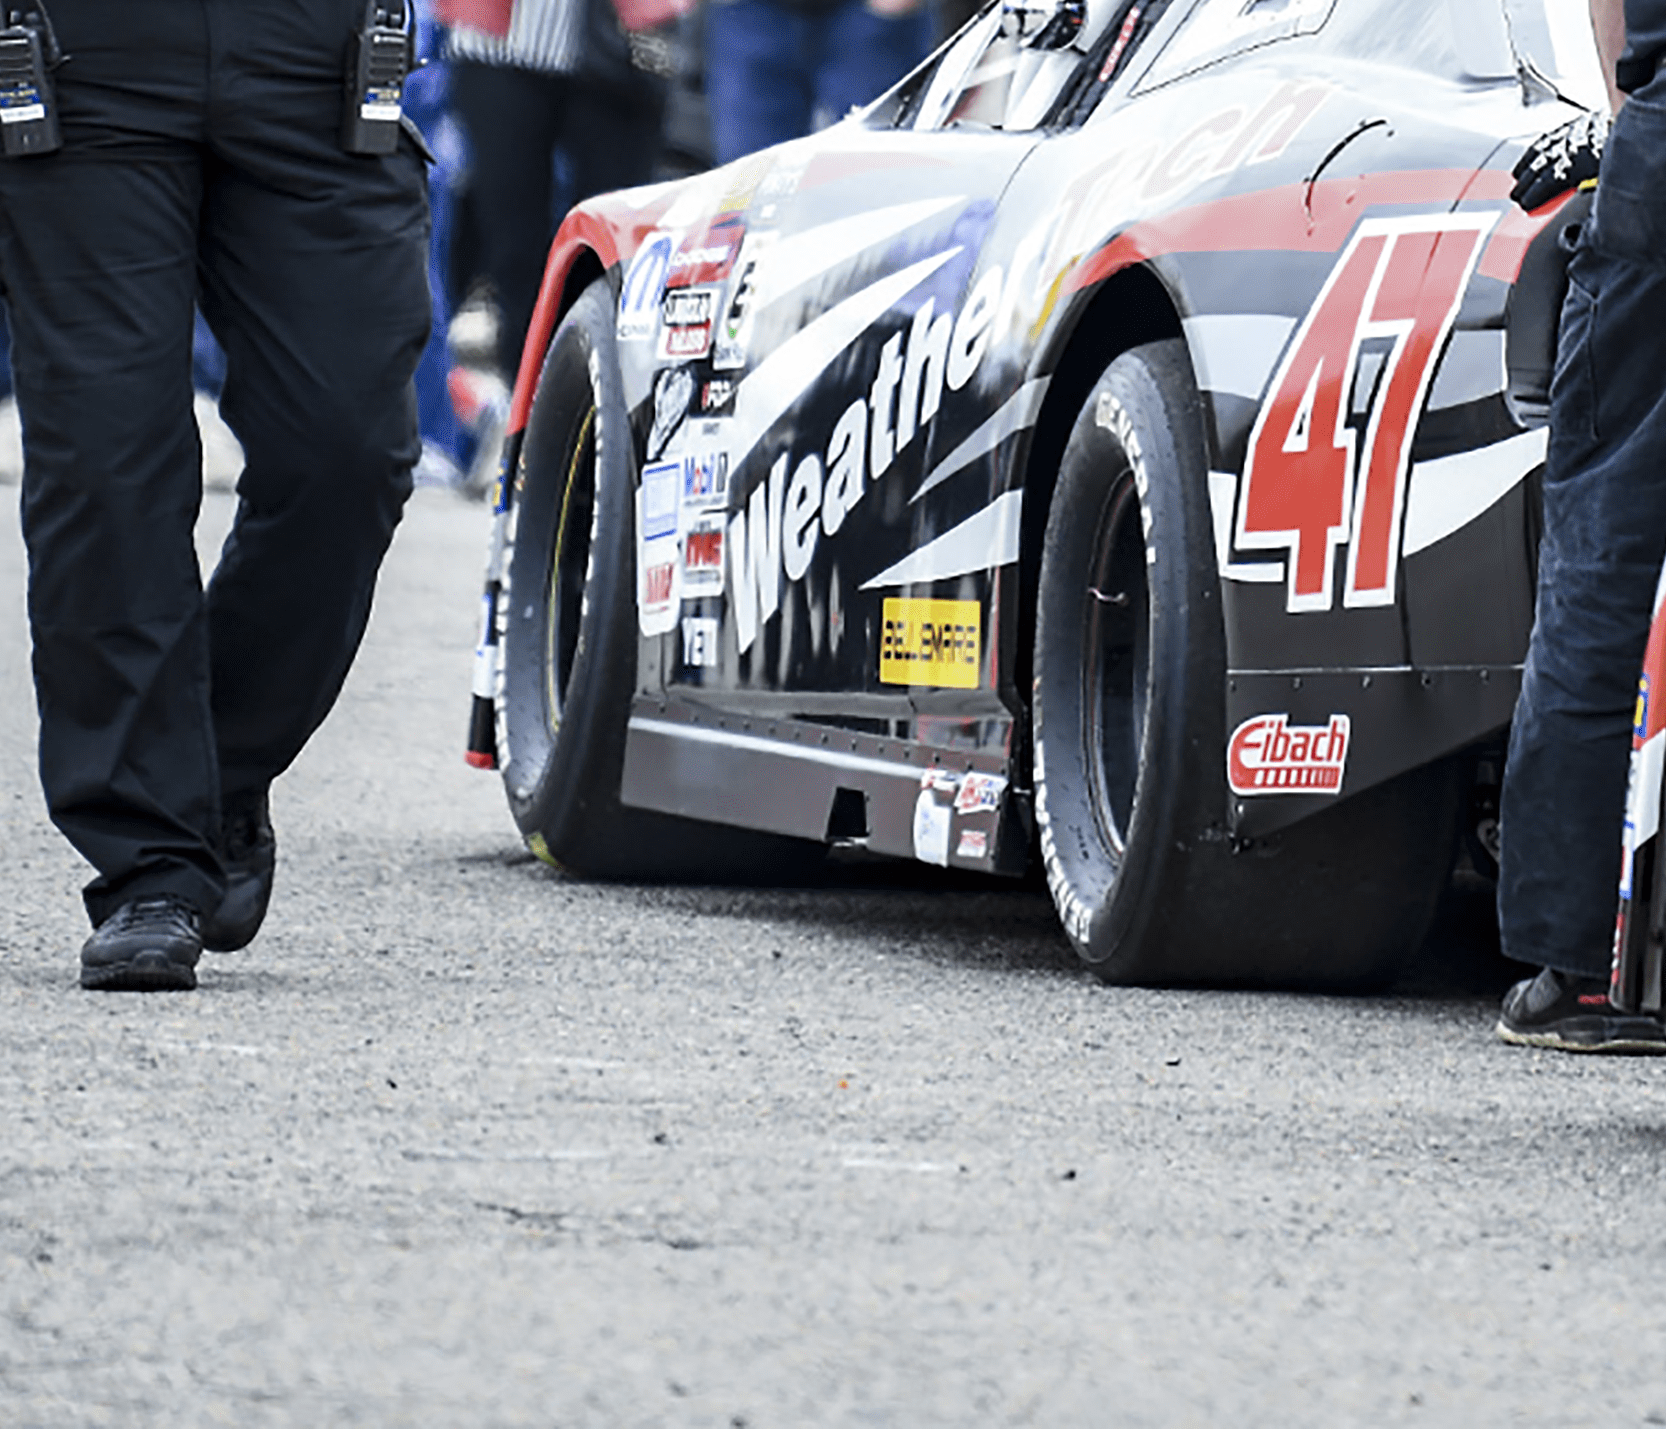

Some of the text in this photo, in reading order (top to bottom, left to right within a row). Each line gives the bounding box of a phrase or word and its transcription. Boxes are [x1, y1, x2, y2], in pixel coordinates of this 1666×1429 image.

[1234, 210, 1502, 613] 47
[883, 620, 977, 665] BELLEMARE
[1230, 719, 1346, 780] Eibach
